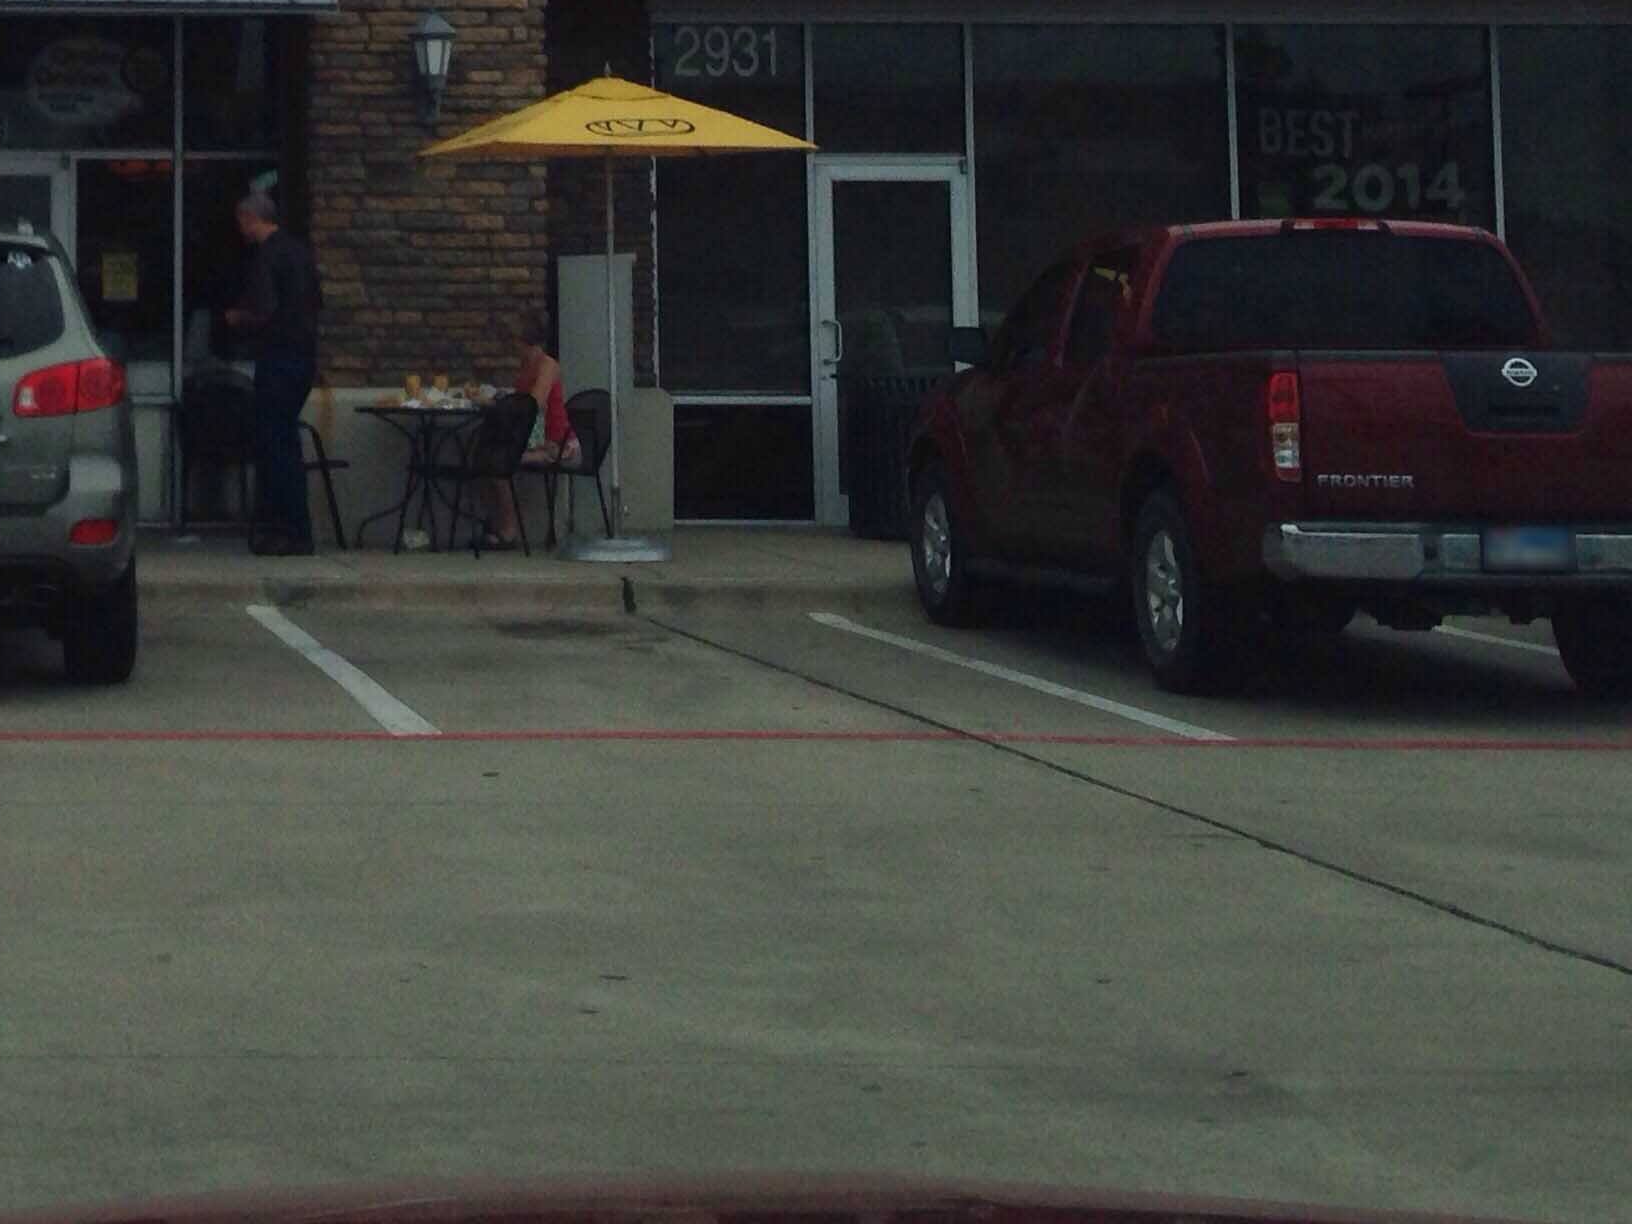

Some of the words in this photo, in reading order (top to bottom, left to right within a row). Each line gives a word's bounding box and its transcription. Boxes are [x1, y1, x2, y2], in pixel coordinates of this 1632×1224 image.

[674, 25, 777, 76] 2931
[1257, 106, 1361, 159] BEST
[1311, 160, 1467, 213] 2014
[1317, 474, 1415, 489] FRONTIER
